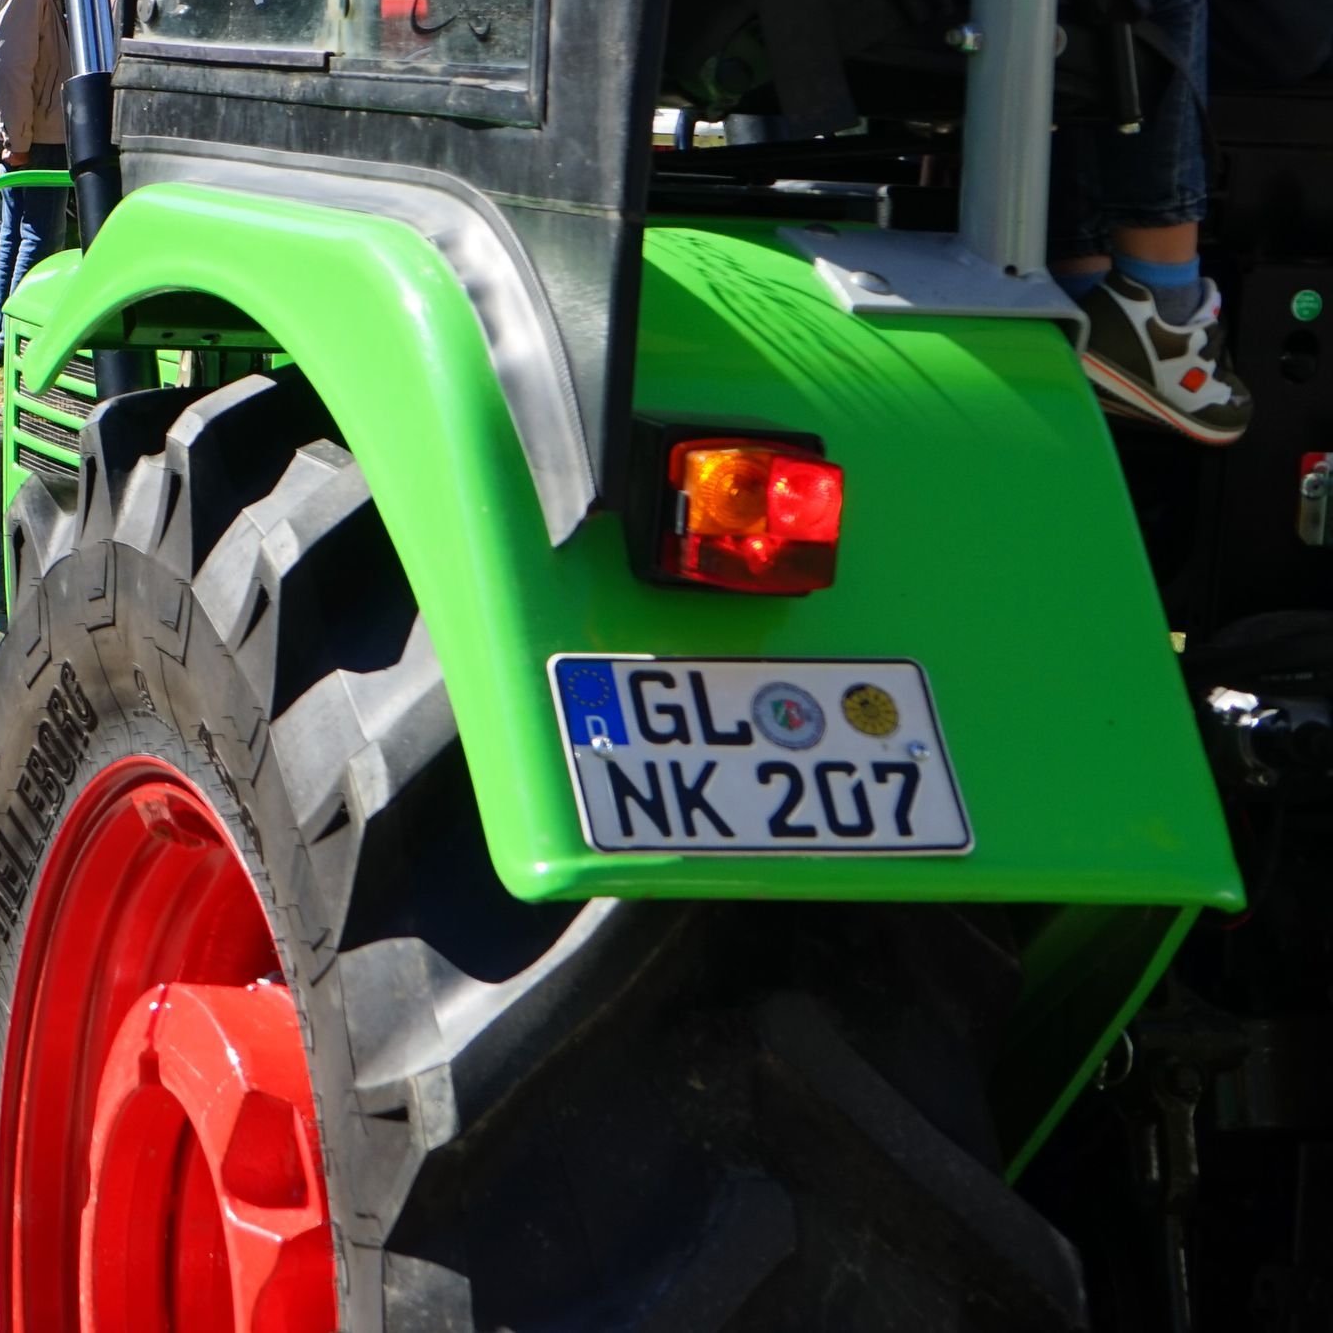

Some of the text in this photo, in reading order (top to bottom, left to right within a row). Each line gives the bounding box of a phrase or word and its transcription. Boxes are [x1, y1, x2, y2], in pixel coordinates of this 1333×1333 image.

[629, 670, 753, 746] GL
[607, 760, 921, 838] NK 207
